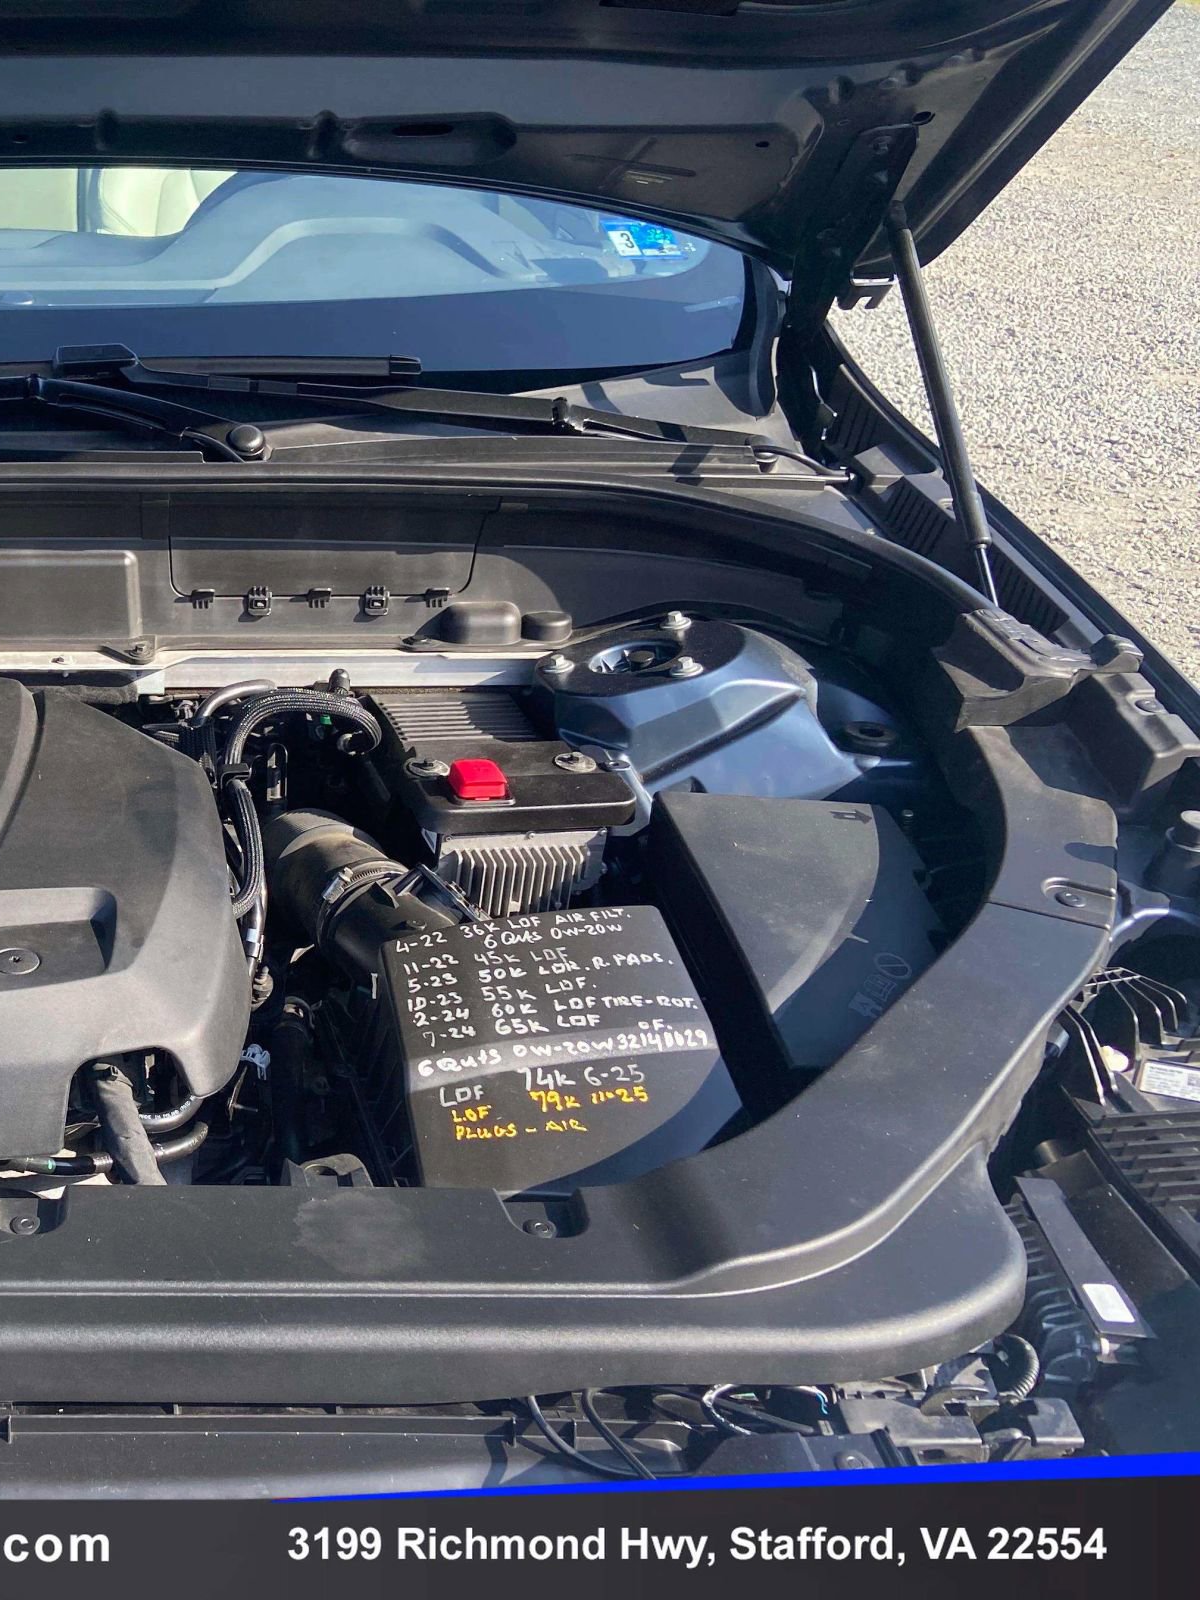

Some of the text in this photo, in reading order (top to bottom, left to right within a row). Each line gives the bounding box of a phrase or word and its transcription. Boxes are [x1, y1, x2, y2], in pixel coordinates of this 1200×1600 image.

[620, 232, 635, 249] 3
[396, 931, 448, 953] 4-22
[555, 912, 585, 925] AIR
[590, 908, 632, 923] FILT.
[403, 954, 459, 975] 11-22
[422, 1025, 476, 1048] 7-24
[584, 1063, 646, 1087] 6-25
[591, 1085, 649, 1104] 11-25
[455, 1121, 518, 1140] PLUGS
[545, 1118, 588, 1133] AIR
